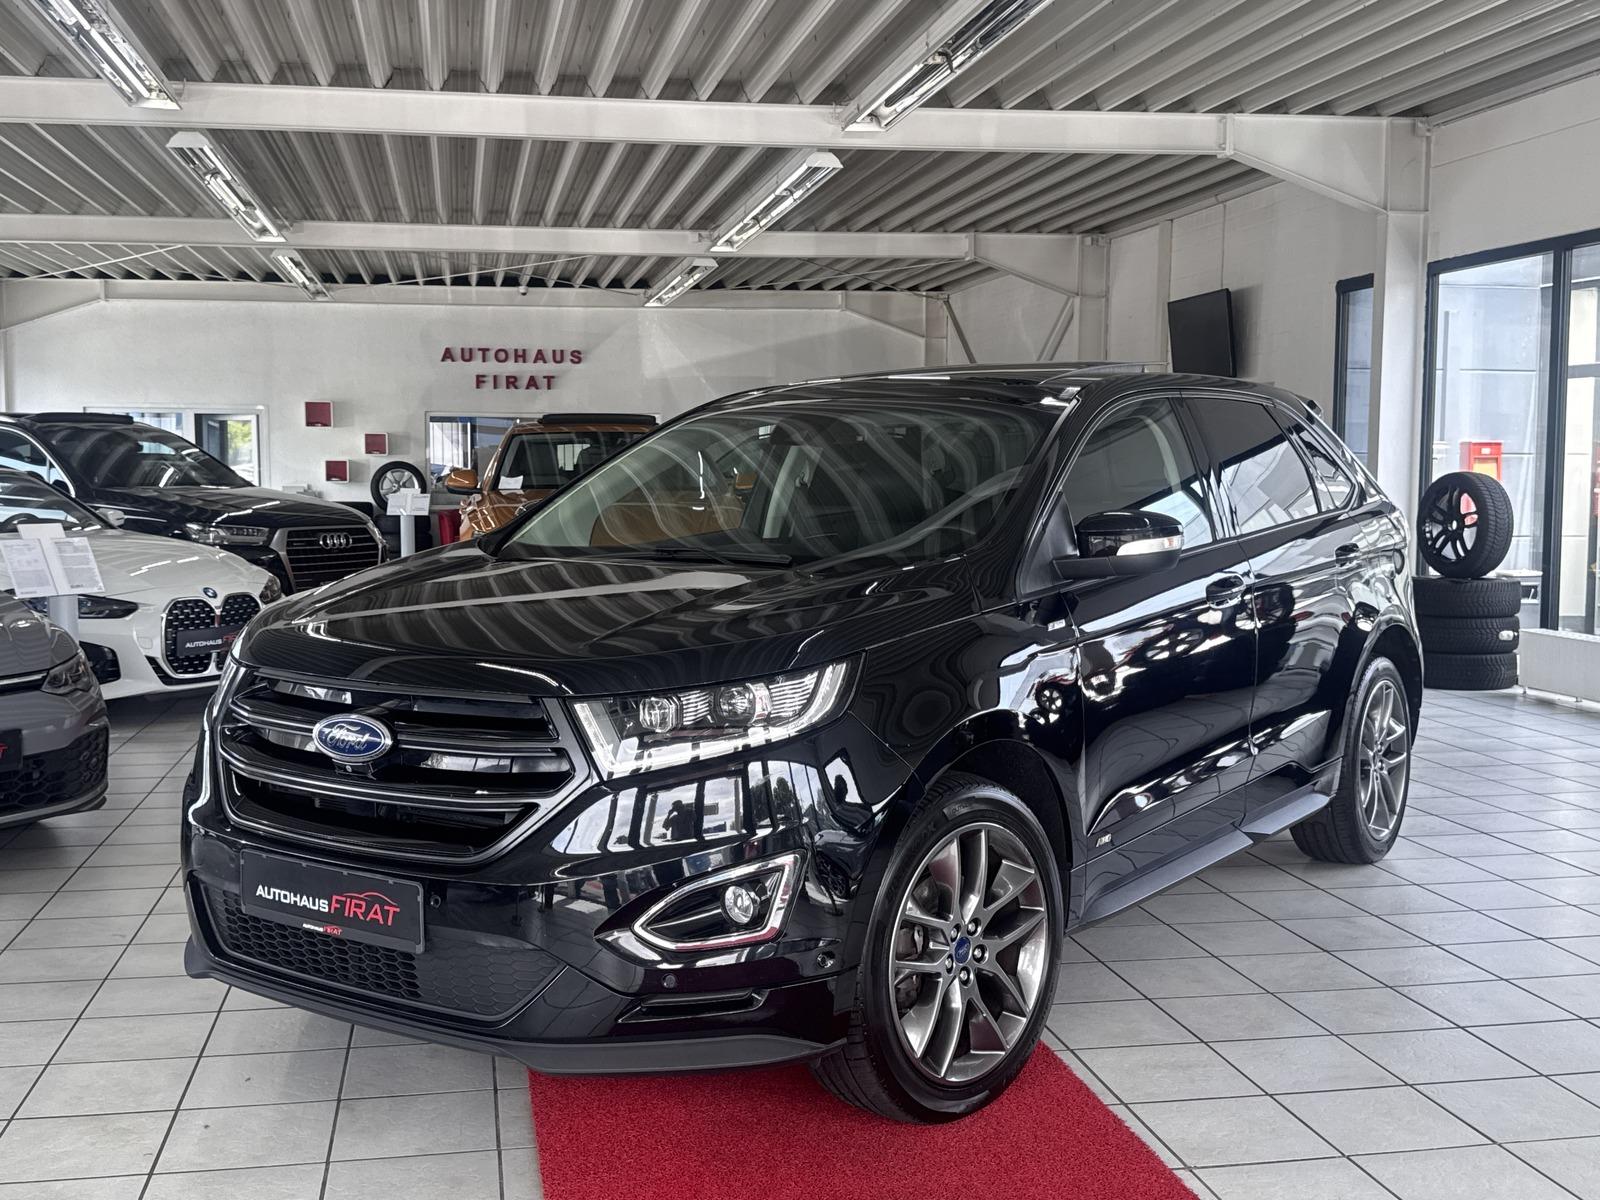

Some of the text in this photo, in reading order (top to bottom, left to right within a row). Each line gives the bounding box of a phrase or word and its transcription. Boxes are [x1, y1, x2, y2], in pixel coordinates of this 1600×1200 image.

[441, 347, 583, 364] AUTOHAUS
[475, 374, 556, 390] FIRAT
[185, 638, 222, 648] AUTOHAUS
[326, 723, 371, 752] Ford
[256, 884, 400, 926] AUTOHAUS FIRAT
